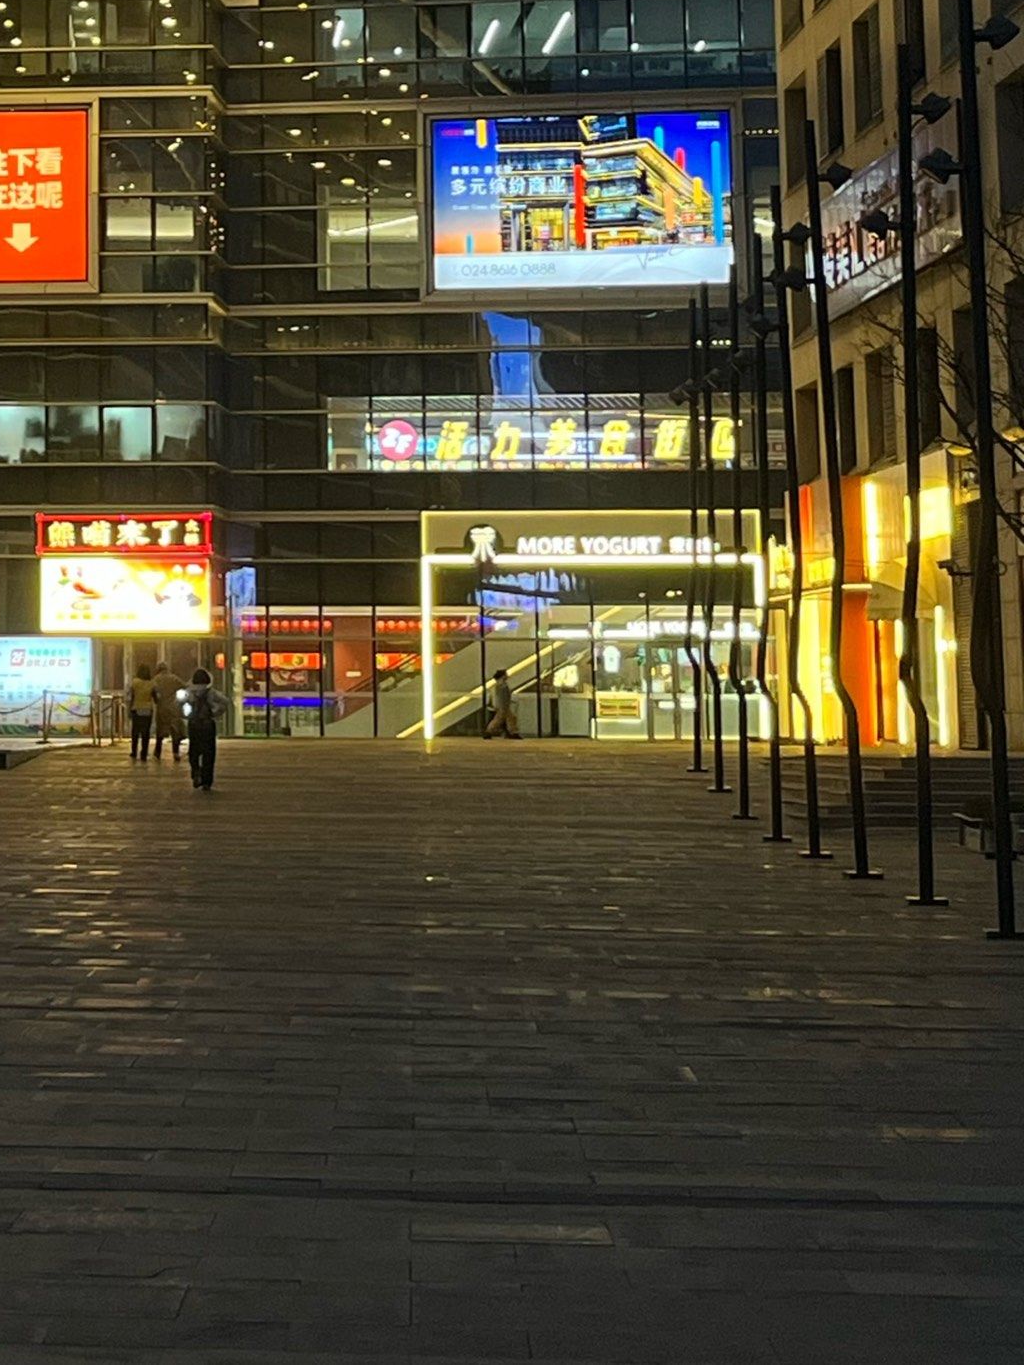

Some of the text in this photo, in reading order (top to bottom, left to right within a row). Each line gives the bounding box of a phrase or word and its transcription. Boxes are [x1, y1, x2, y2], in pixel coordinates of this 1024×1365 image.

[450, 176, 566, 196] 多元缤纷商业
[381, 428, 413, 453] 2F
[48, 519, 178, 548] 熊喵来了
[517, 536, 576, 555] MORE
[580, 536, 662, 555] YOGURT
